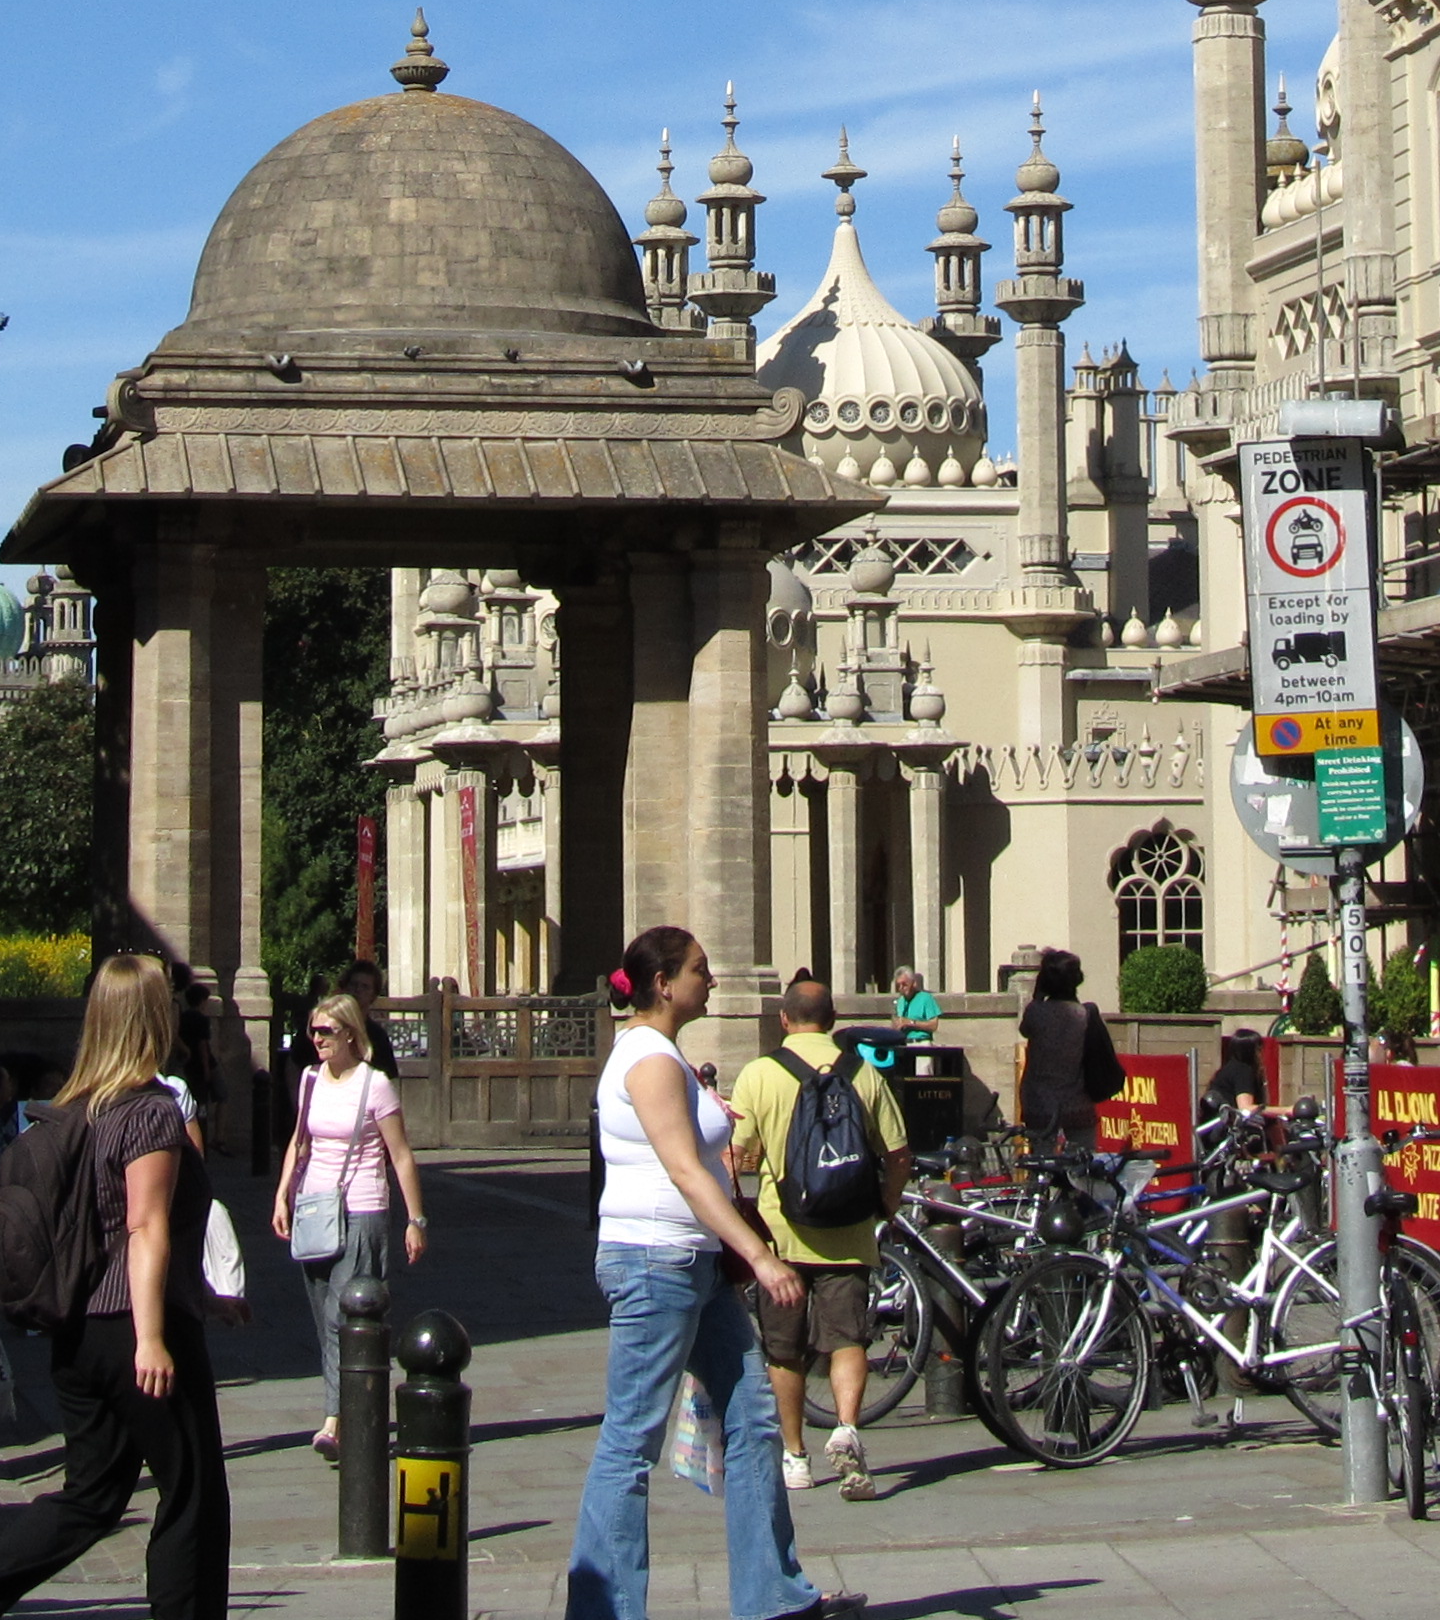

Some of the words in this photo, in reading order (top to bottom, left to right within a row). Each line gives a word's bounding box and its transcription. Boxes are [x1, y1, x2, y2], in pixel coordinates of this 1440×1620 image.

[1253, 447, 1346, 465] PEDESTRIAN
[1261, 467, 1342, 494] ZONE
[1268, 596, 1320, 610] Except
[1327, 594, 1348, 606] for
[1270, 612, 1324, 626] loading
[1331, 610, 1350, 624] by
[1281, 676, 1346, 688] between
[1274, 690, 1354, 707] 4pm-10am
[1315, 718, 1332, 730] At
[1339, 718, 1364, 730] any
[1324, 734, 1358, 746] time
[1348, 909, 1363, 980] 501
[918, 1091, 952, 1099] LITTER
[399, 1470, 450, 1548] H
